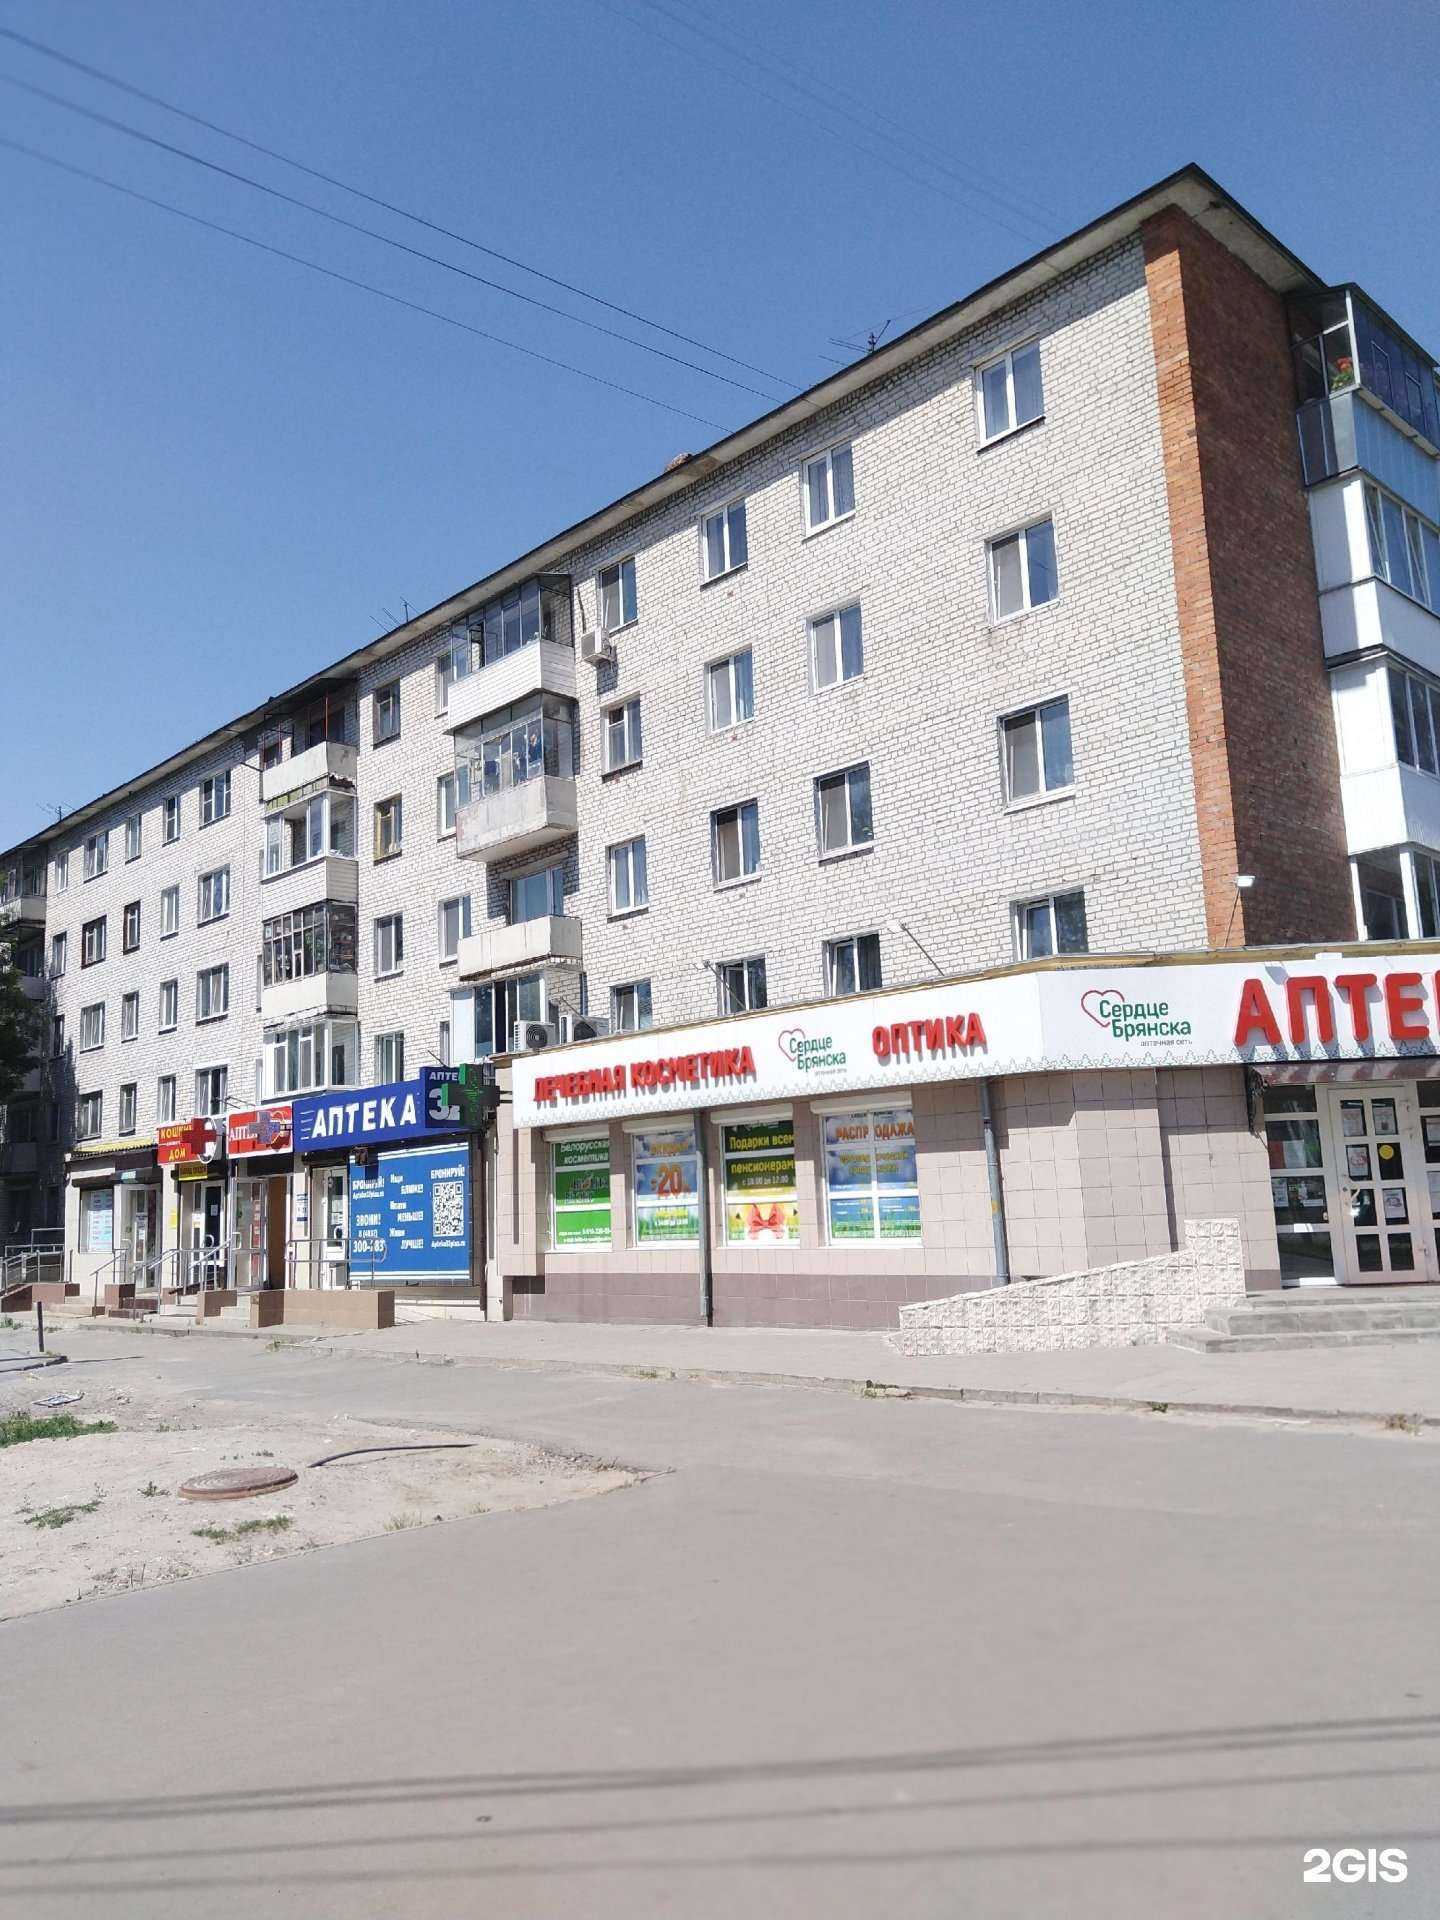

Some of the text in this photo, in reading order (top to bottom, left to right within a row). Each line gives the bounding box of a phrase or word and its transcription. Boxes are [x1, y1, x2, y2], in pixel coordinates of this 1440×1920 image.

[1099, 999, 1169, 1021] Сердце
[1233, 970, 1440, 1047] АПТЕ
[872, 1012, 987, 1057] ОПТИКА
[1111, 1019, 1192, 1042] Брянска
[789, 1036, 833, 1056] Сердце
[797, 1051, 847, 1072] Брянска
[429, 1071, 458, 1081] АПТЕ
[533, 1046, 757, 1102] ЛЕЧЕБНАЯ КОСМЕТИКА
[311, 1093, 417, 1139] АПТЕКА
[729, 1136, 770, 1151] Подарки
[169, 1148, 186, 1161] ДОМ
[356, 1212, 381, 1227] ЗВОНИ!
